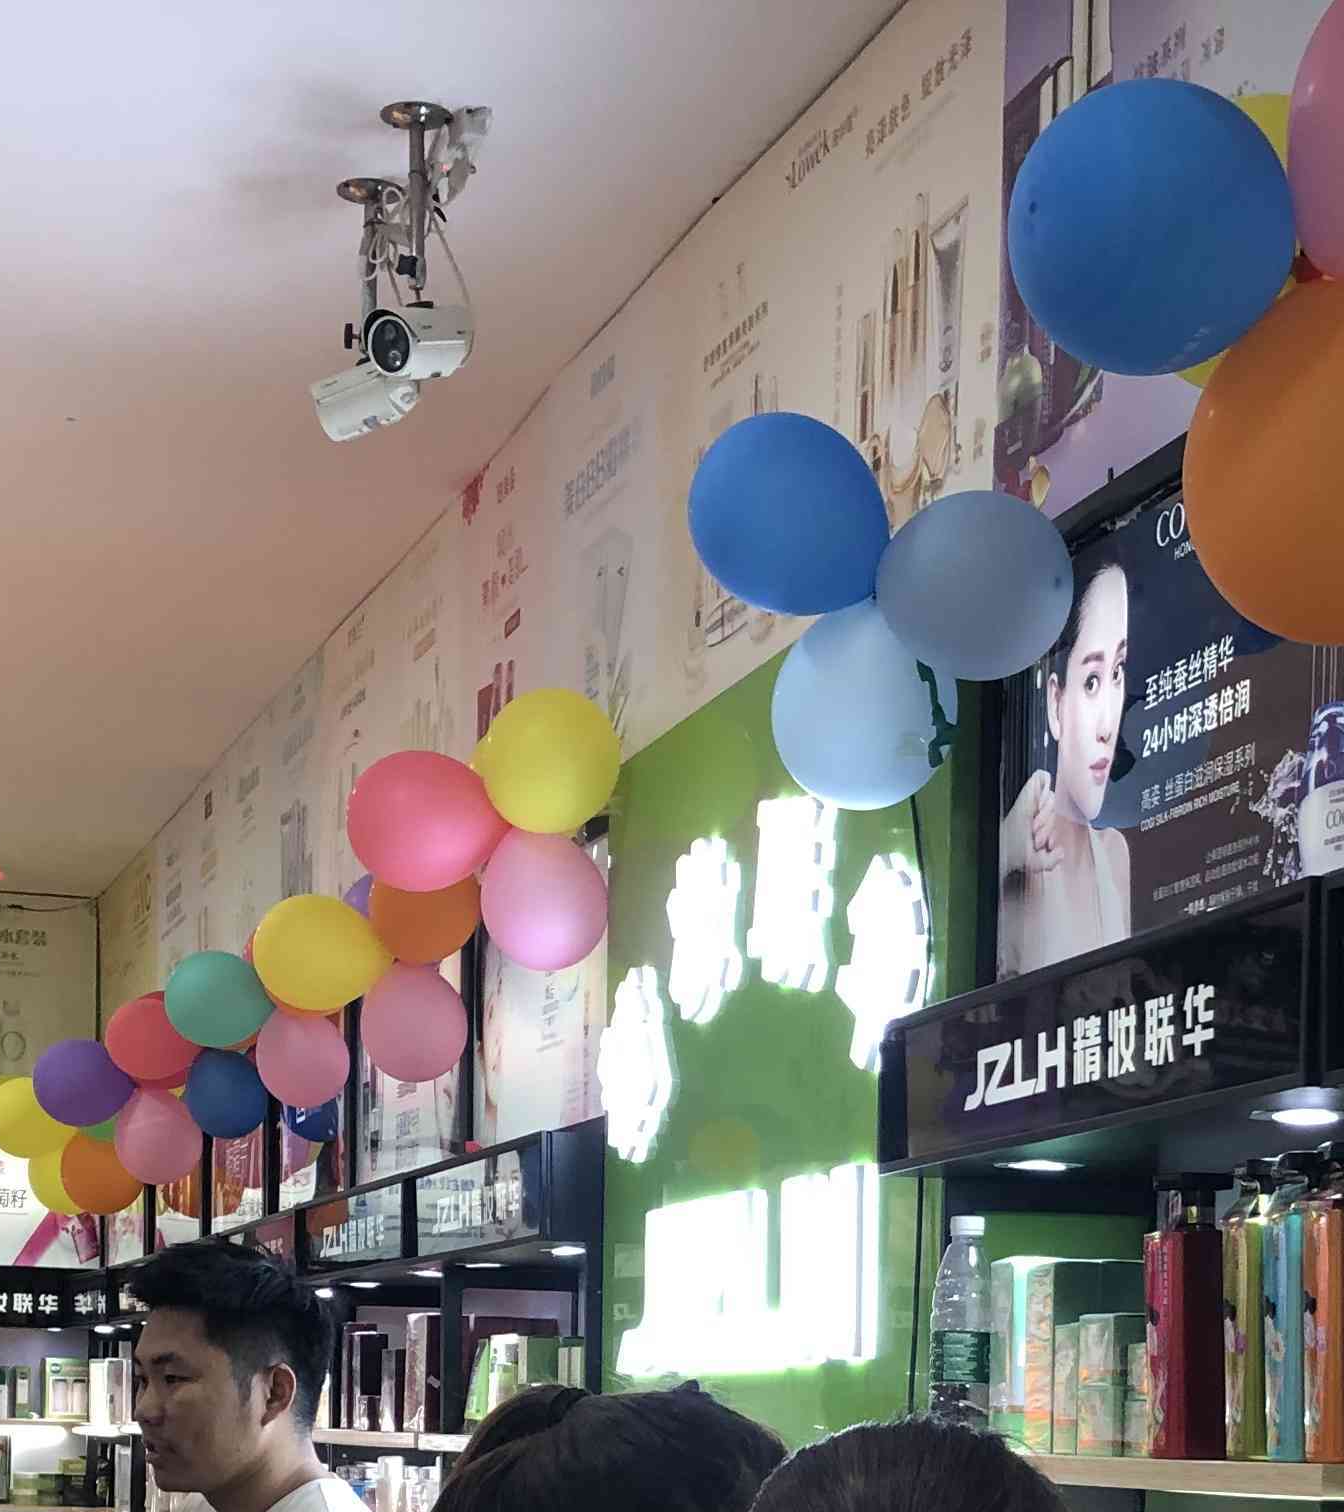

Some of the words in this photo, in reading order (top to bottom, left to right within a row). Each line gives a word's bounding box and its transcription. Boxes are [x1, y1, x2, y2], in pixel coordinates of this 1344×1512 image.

[1156, 503, 1186, 547] CO
[1144, 634, 1235, 711] 至纯蚕丝精华
[1143, 679, 1251, 758] 24小时深透倍润
[1073, 983, 1215, 1086] 精妆联华
